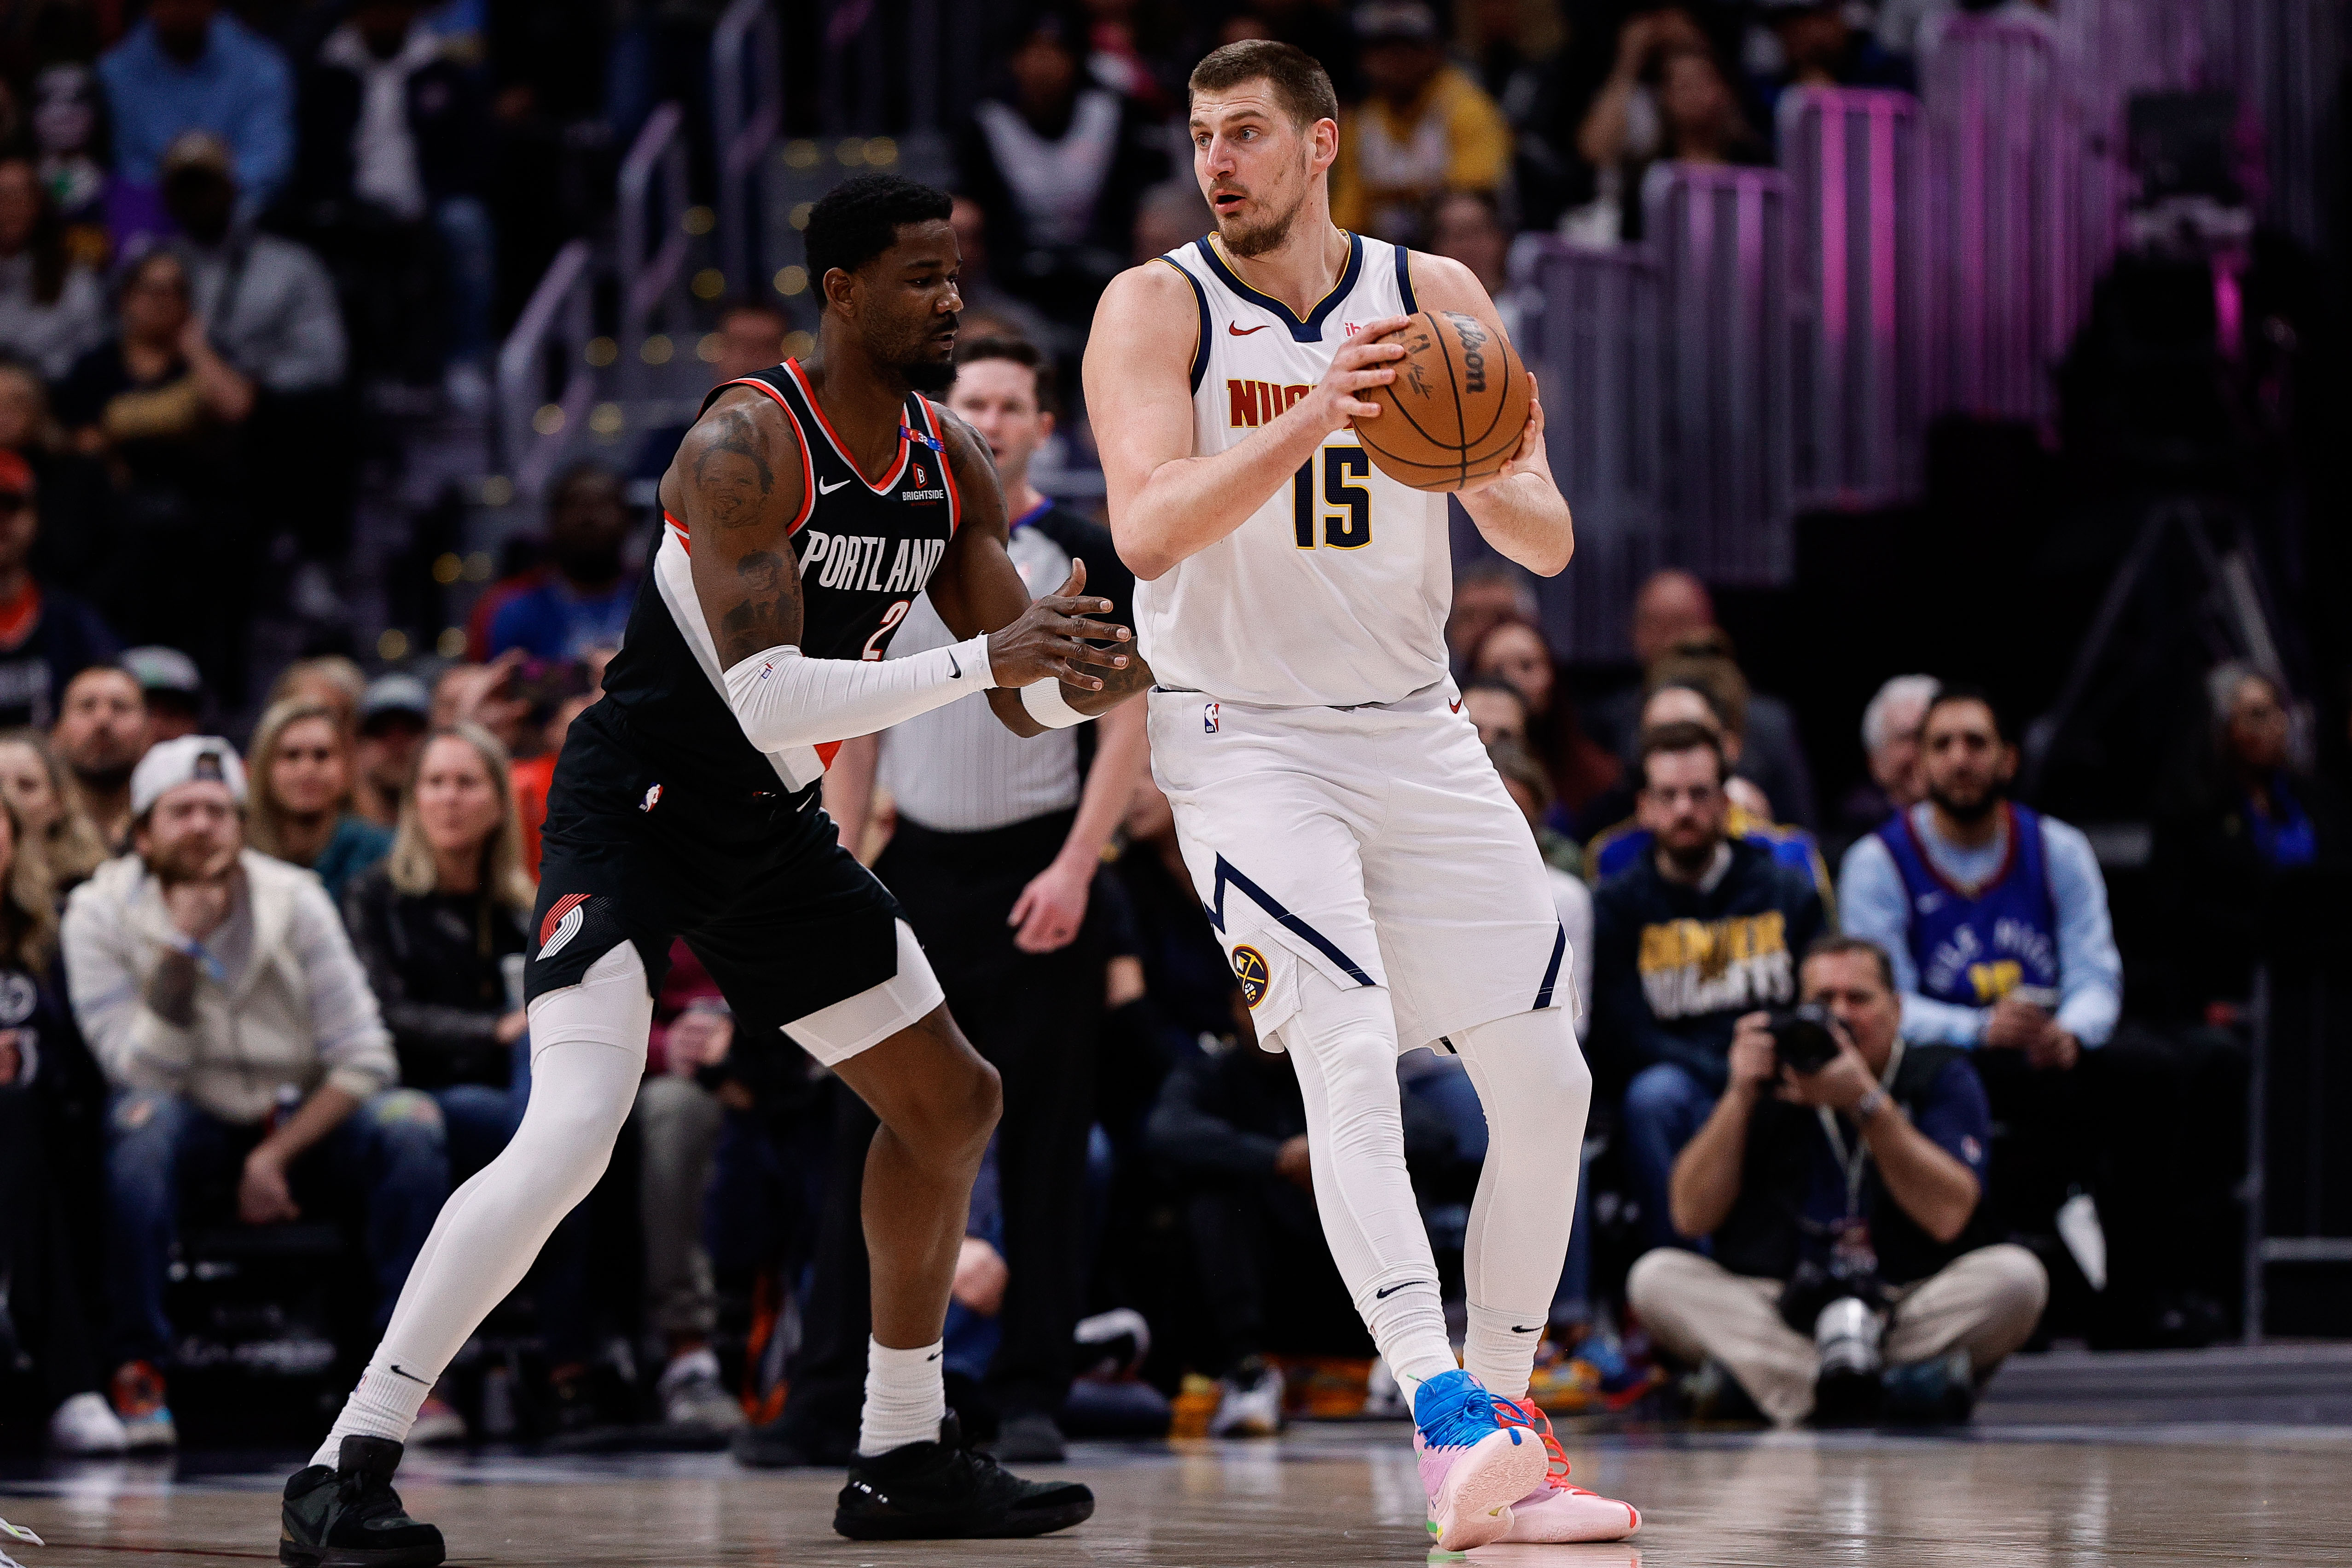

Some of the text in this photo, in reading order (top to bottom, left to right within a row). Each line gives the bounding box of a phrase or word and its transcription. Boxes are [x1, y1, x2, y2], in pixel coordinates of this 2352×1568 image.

[902, 489, 944, 501] BRIGHTSIDE
[917, 468, 925, 484] B
[1292, 444, 1372, 550] 15
[799, 529, 946, 592] PORTLAND
[862, 599, 911, 662] 2
